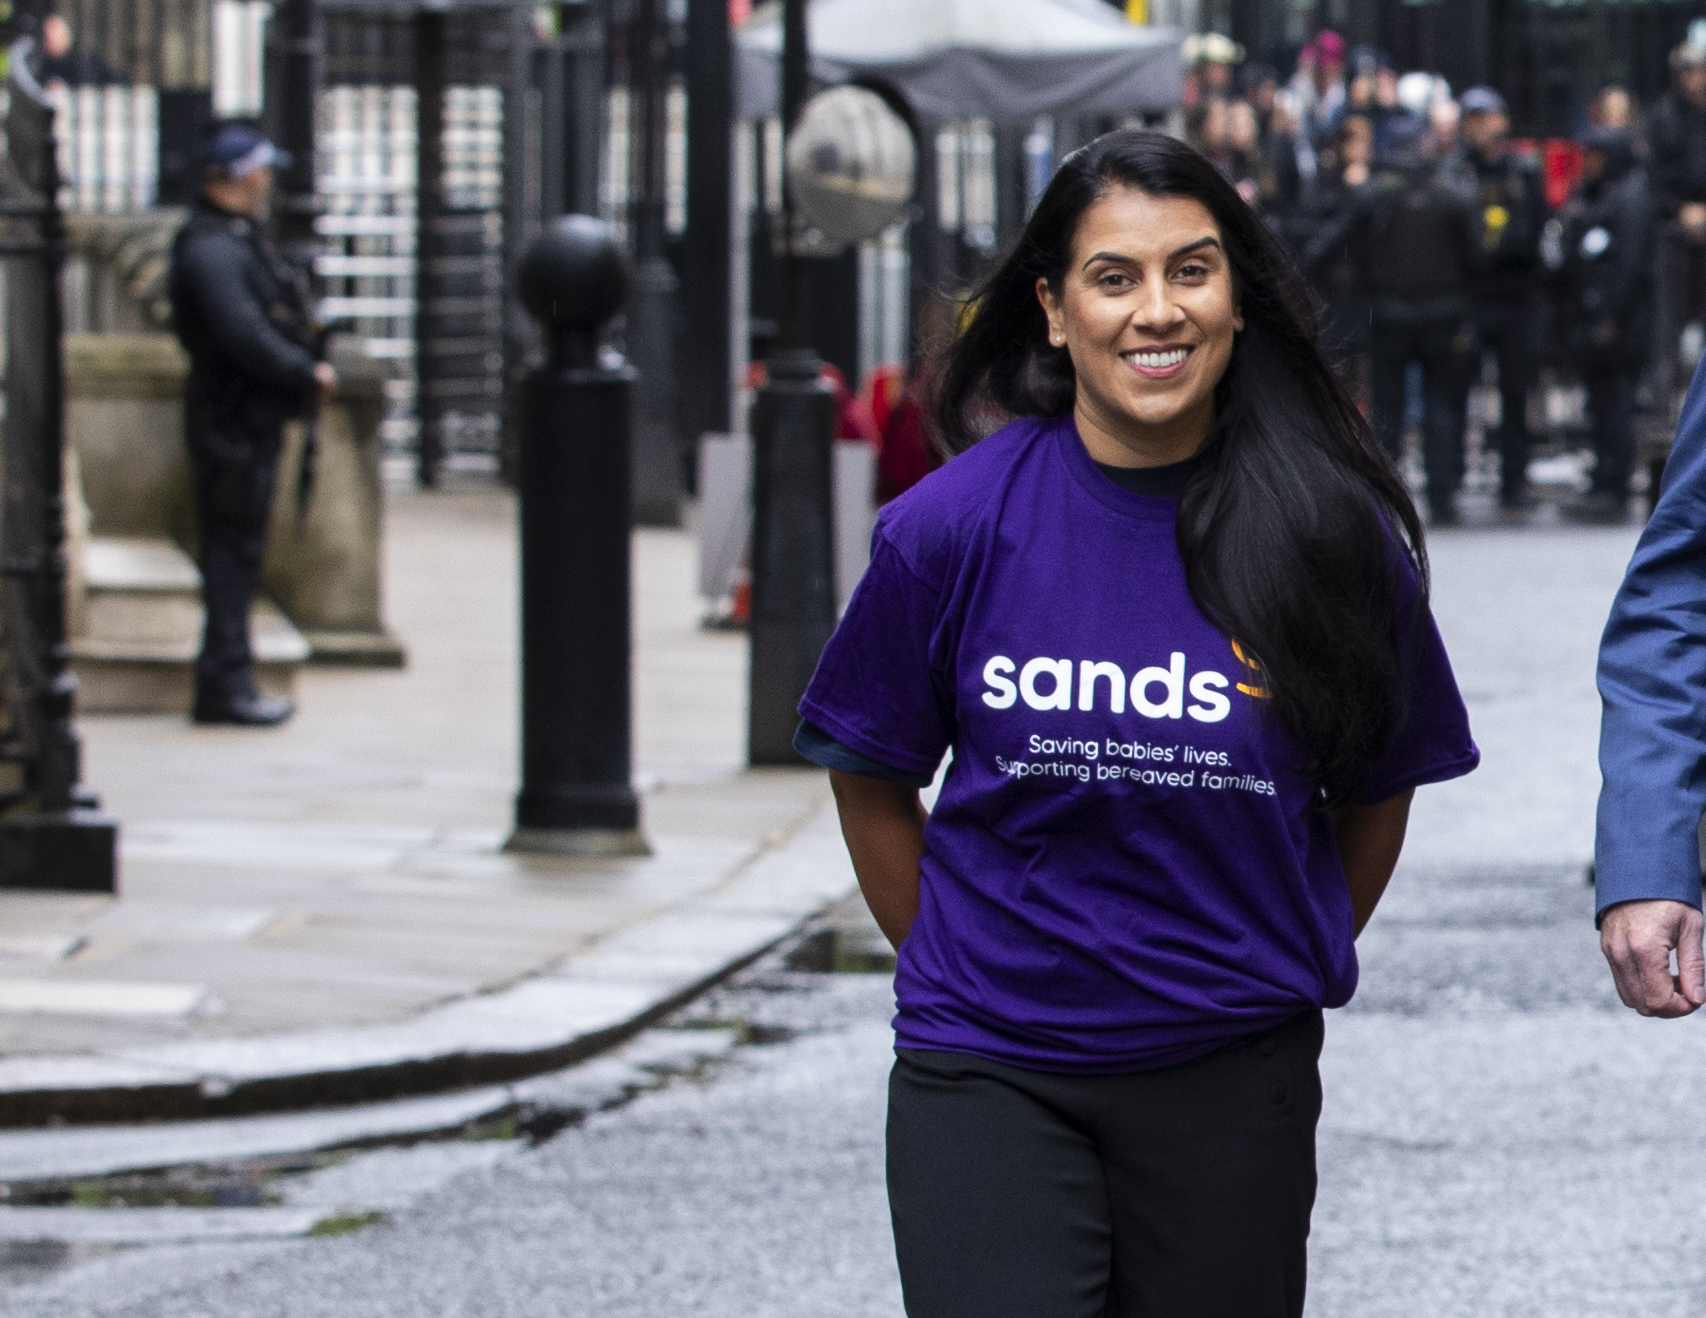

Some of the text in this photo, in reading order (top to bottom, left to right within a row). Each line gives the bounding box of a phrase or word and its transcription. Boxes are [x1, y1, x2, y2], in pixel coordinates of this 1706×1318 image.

[981, 651, 1231, 723] sands
[1028, 734, 1099, 760] Saving
[1183, 745, 1233, 767] lives.
[1097, 762, 1195, 788] bereaved
